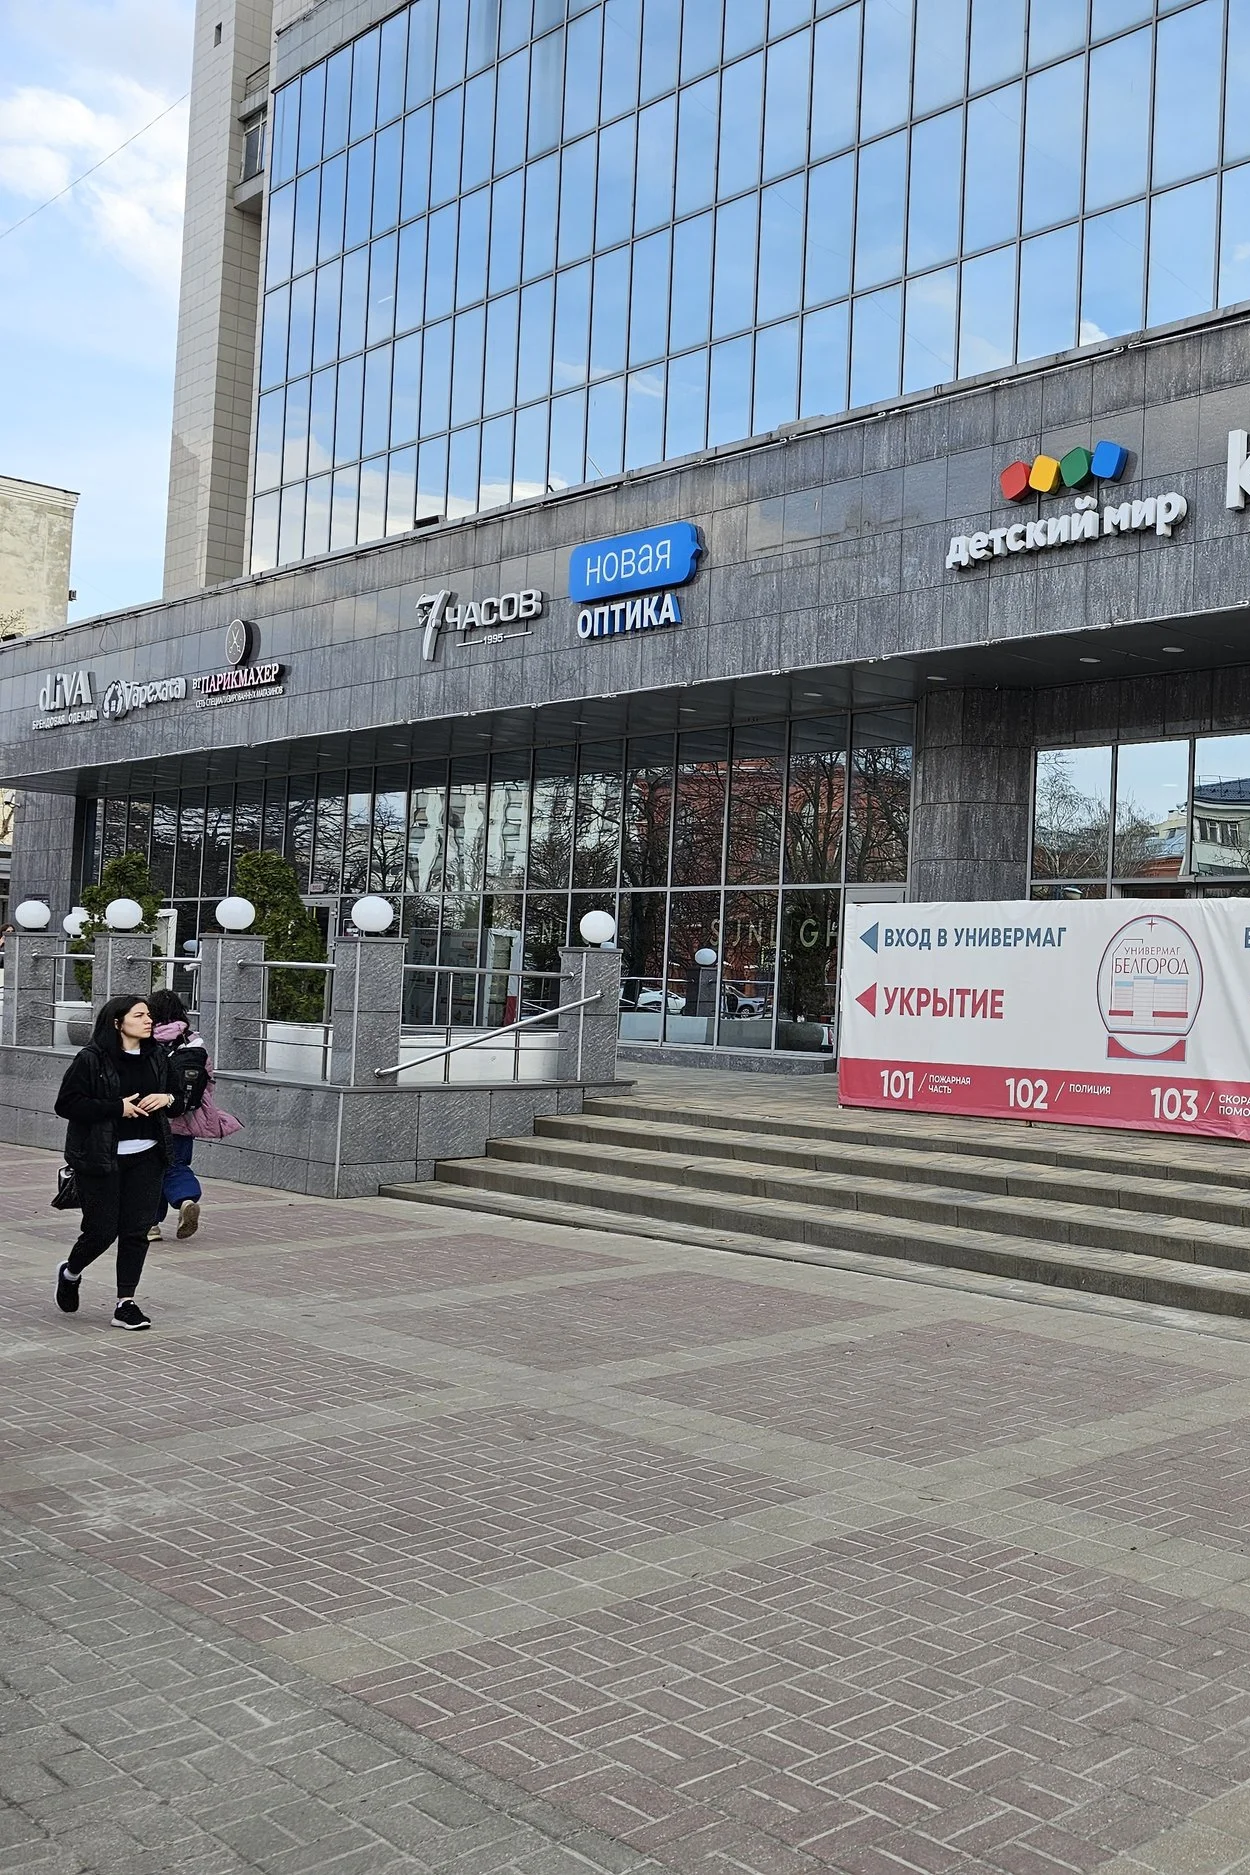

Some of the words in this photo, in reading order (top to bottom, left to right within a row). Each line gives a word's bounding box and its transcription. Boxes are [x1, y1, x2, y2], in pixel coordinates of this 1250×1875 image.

[946, 496, 1100, 569] детский
[1103, 491, 1187, 538] мир
[445, 589, 542, 630] ЧАСОВ
[577, 593, 681, 639] ОПТИКА
[483, 634, 504, 645] 1995
[201, 662, 279, 693] ПАРИКМАХЕР
[256, 686, 283, 698] МАГАЗИНОВ
[32, 714, 67, 730] БРЕНДОВАЯ
[69, 709, 97, 724] ОДЕЖДА
[884, 928, 932, 950] ВХОД
[937, 929, 948, 947] В
[954, 927, 1067, 948] УНИВЕРМАГ
[1124, 946, 1181, 956] УНИВЕРМАГ
[1114, 957, 1190, 975] БЕЛГОРОД
[884, 986, 1005, 1020] УКРЫТИЕ
[880, 1070, 915, 1099] 101
[928, 1084, 952, 1094] ЧАСТЬ
[929, 1074, 971, 1085] ПОЖАРНАЯ
[1069, 1083, 1111, 1095] ПОЛИЦИЯ
[1005, 1078, 1049, 1110] 102
[1150, 1087, 1199, 1122] 103
